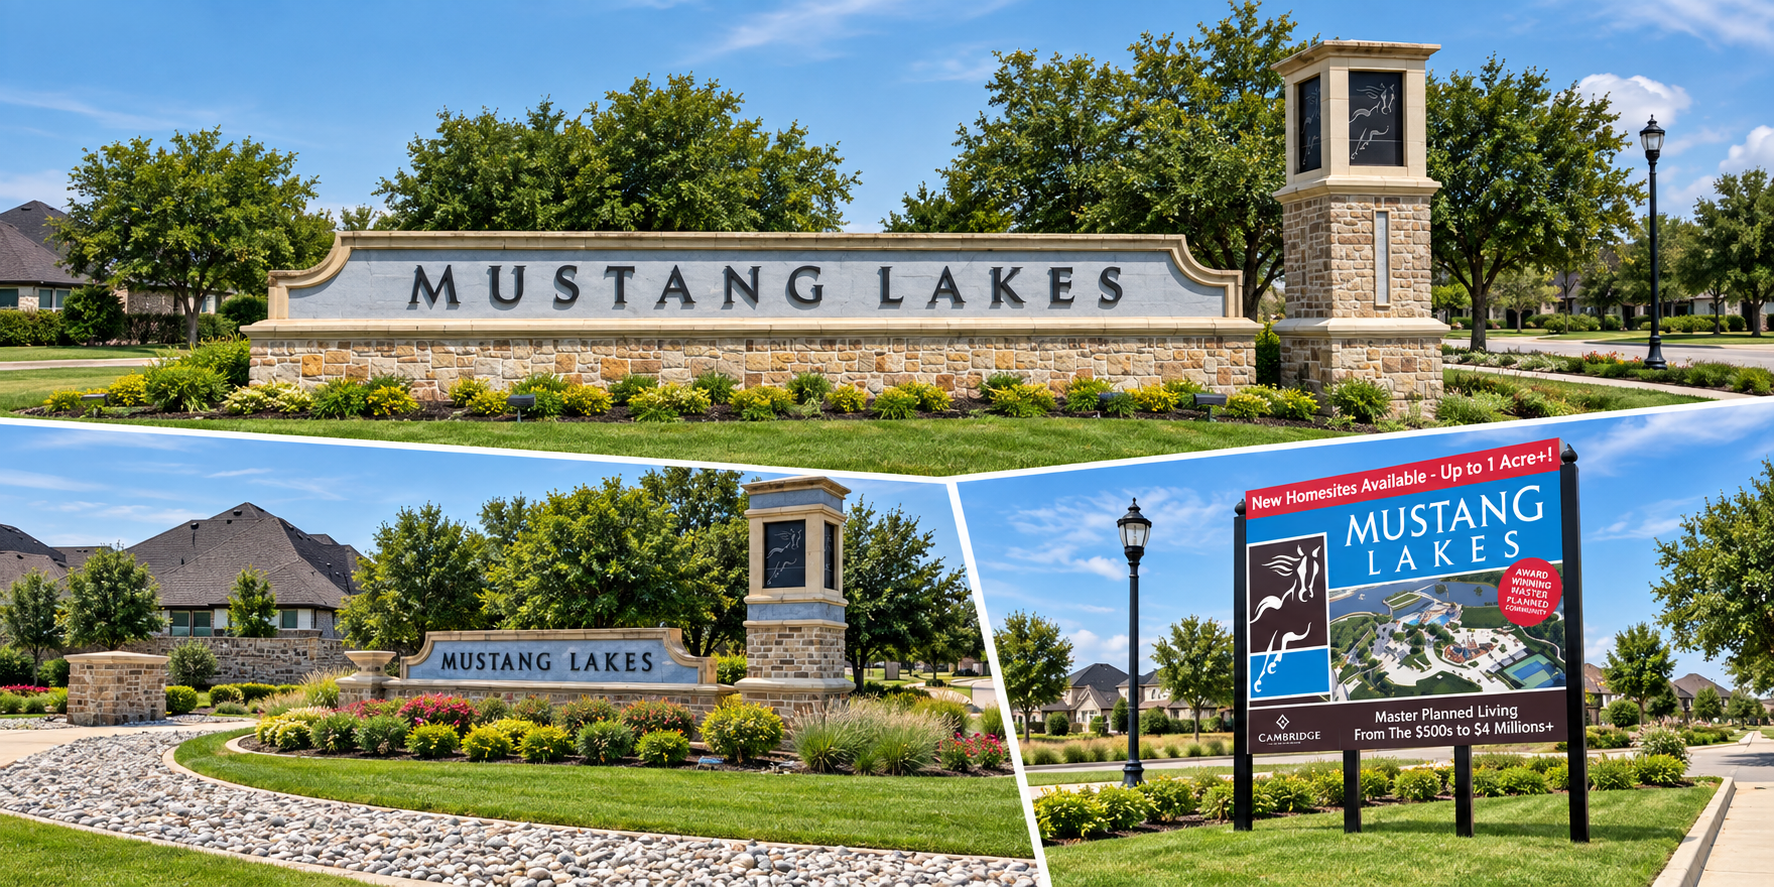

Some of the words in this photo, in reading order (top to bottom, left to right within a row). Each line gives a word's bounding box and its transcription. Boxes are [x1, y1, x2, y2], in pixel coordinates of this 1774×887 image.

[408, 264, 825, 308] MUSTANG
[880, 264, 1124, 308] LAKES
[1252, 495, 1282, 510] New
[1286, 483, 1357, 505] Homesites
[1361, 469, 1427, 493] Available
[1441, 463, 1462, 482] Up
[1466, 462, 1482, 474] to
[1487, 457, 1493, 471] 1
[1499, 446, 1553, 470] Acre+!
[1344, 485, 1544, 547] MUSTANG
[1368, 530, 1520, 576] LAKES
[1511, 577, 1552, 590] WINNING
[1515, 568, 1549, 580] AWARD
[1506, 596, 1549, 608] PLANNED
[441, 652, 551, 671] MUSTANG
[570, 652, 653, 672] LAKES
[1375, 710, 1418, 723] Master
[1422, 705, 1474, 721] Planned
[1478, 704, 1519, 719] Living
[1258, 730, 1321, 743] CAMBRIDGE
[1354, 728, 1385, 741] From
[1388, 727, 1412, 739] The
[1416, 724, 1453, 739] $500s
[1456, 724, 1470, 737] to
[1474, 722, 1490, 737] $4
[1494, 721, 1554, 735] Millions+
